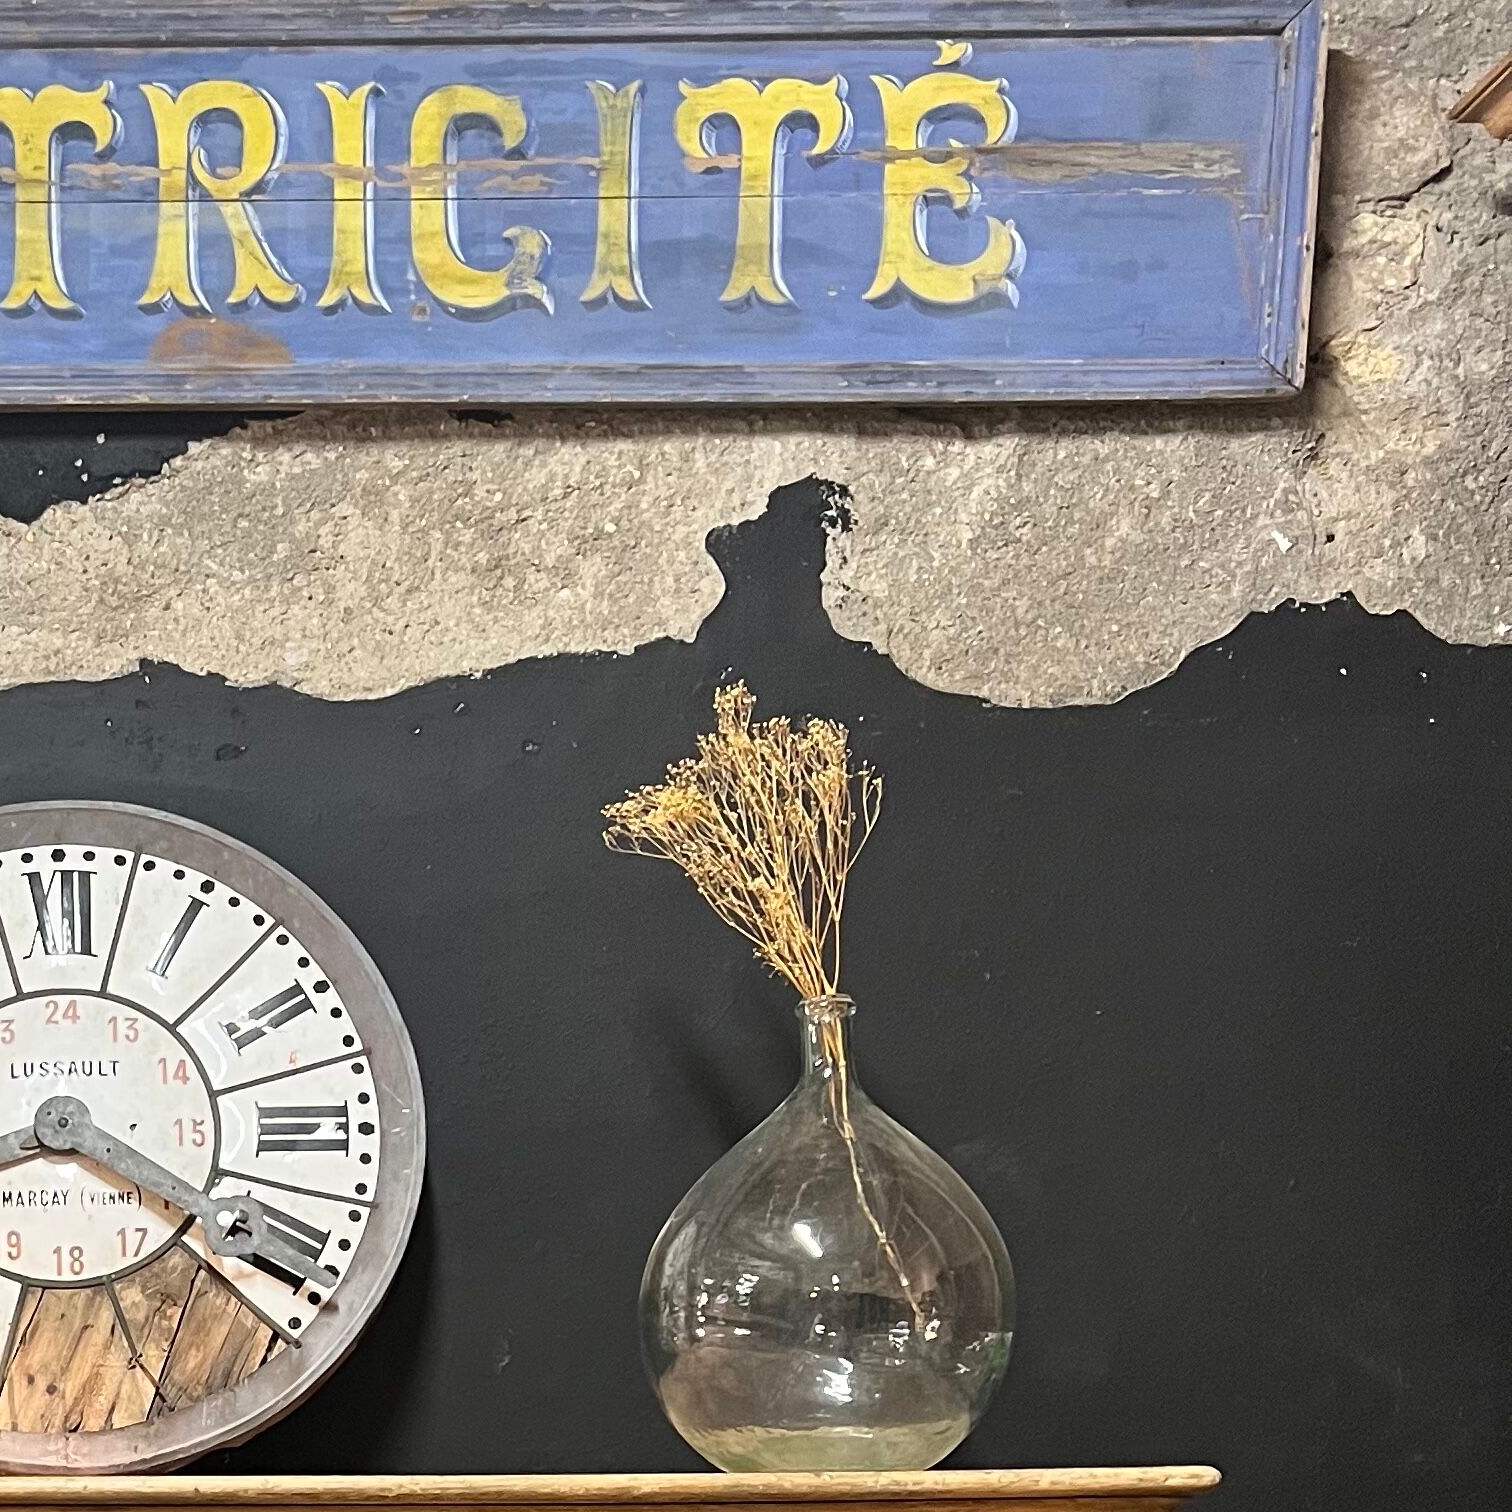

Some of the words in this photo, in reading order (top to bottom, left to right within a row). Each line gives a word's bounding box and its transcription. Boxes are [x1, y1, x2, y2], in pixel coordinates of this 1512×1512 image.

[21, 870, 98, 960] XII
[45, 999, 81, 1026] 24
[107, 1015, 140, 1044] 13
[10, 1060, 121, 1081] LUSSAULT
[158, 1057, 190, 1086] 14
[173, 1117, 206, 1148] 15
[254, 1100, 349, 1158] III
[80, 1182, 142, 1212] (VIENNE)
[117, 1227, 148, 1258] 17
[52, 1245, 85, 1276] 18
